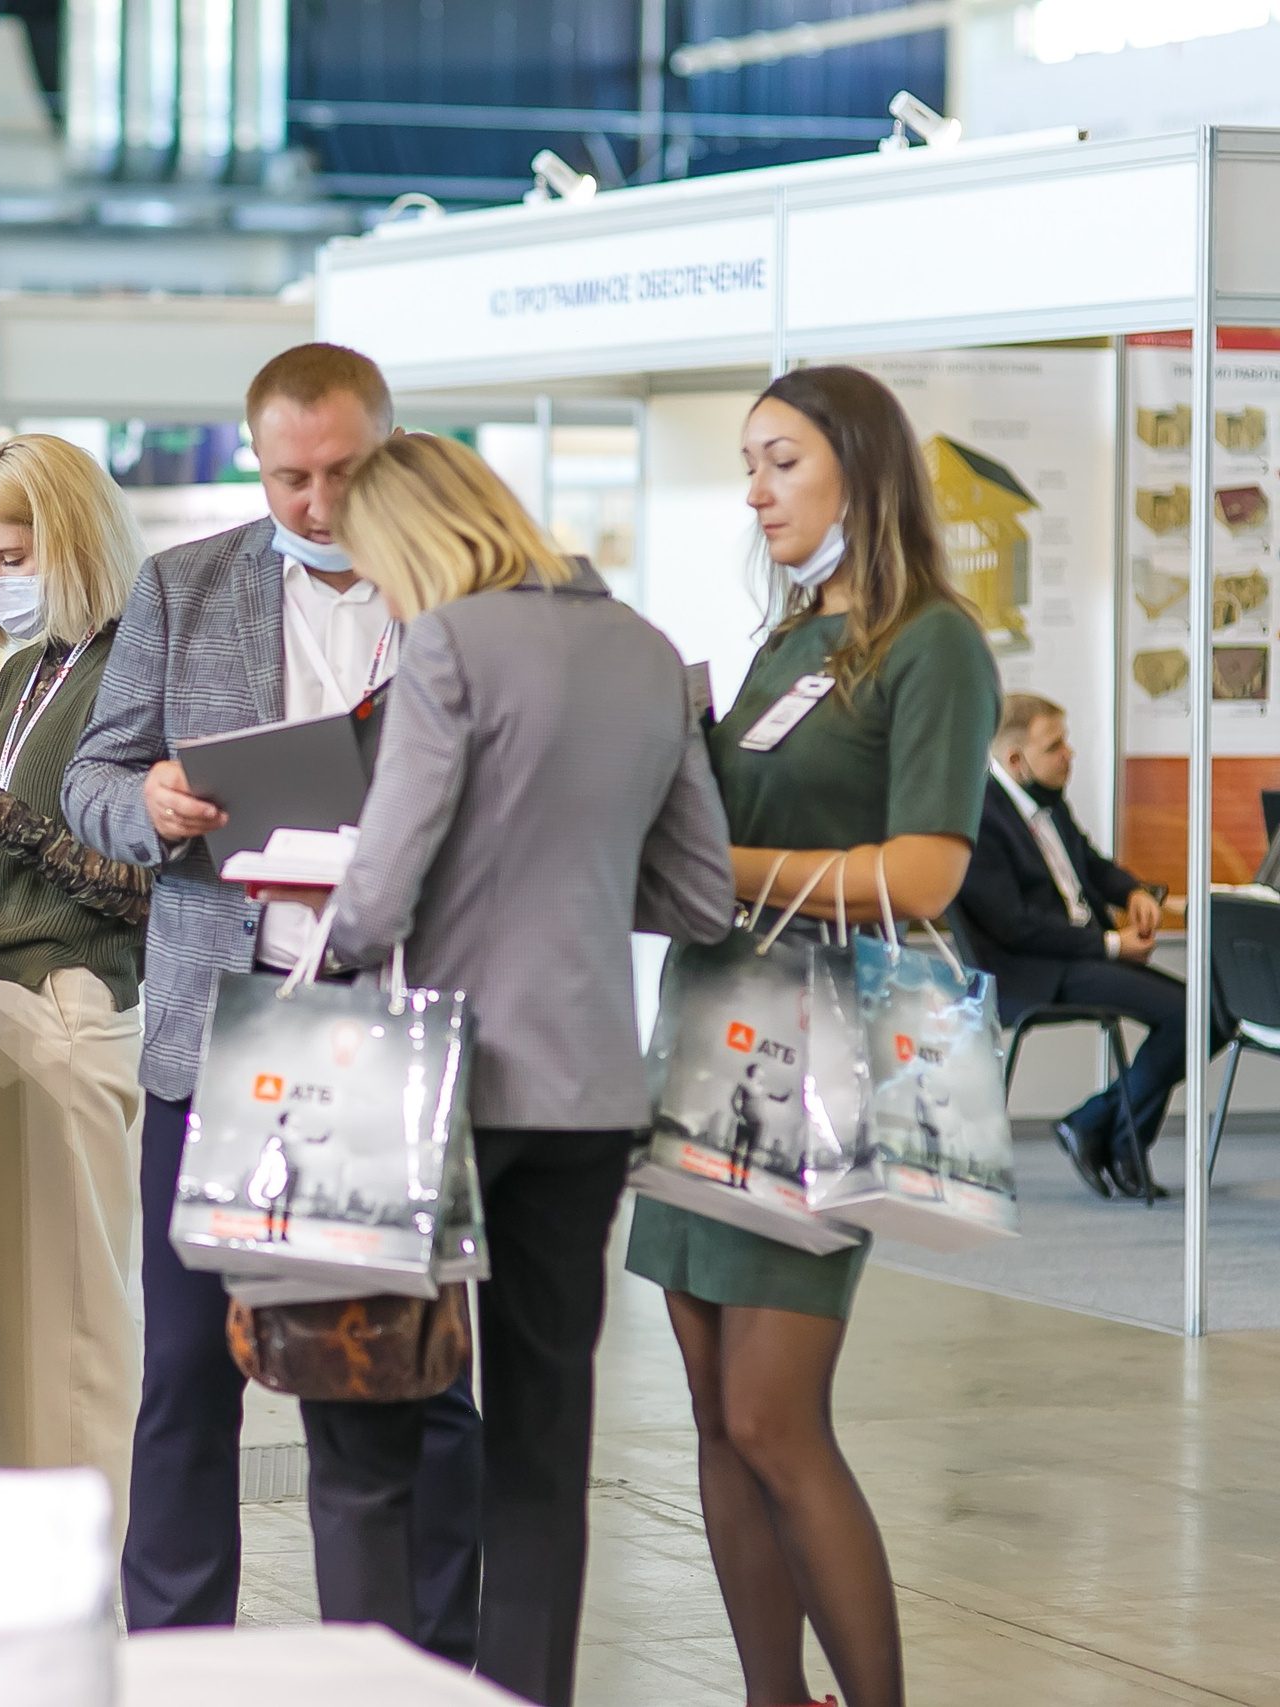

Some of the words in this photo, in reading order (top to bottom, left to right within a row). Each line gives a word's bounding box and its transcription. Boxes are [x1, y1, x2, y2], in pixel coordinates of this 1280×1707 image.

[515, 272, 632, 314] ПРОГРАММНОЕ
[638, 257, 767, 301] ОБЕСПЕЧЕНИЕ
[757, 1040, 796, 1066] АТБ
[289, 1082, 334, 1105] АТБ
